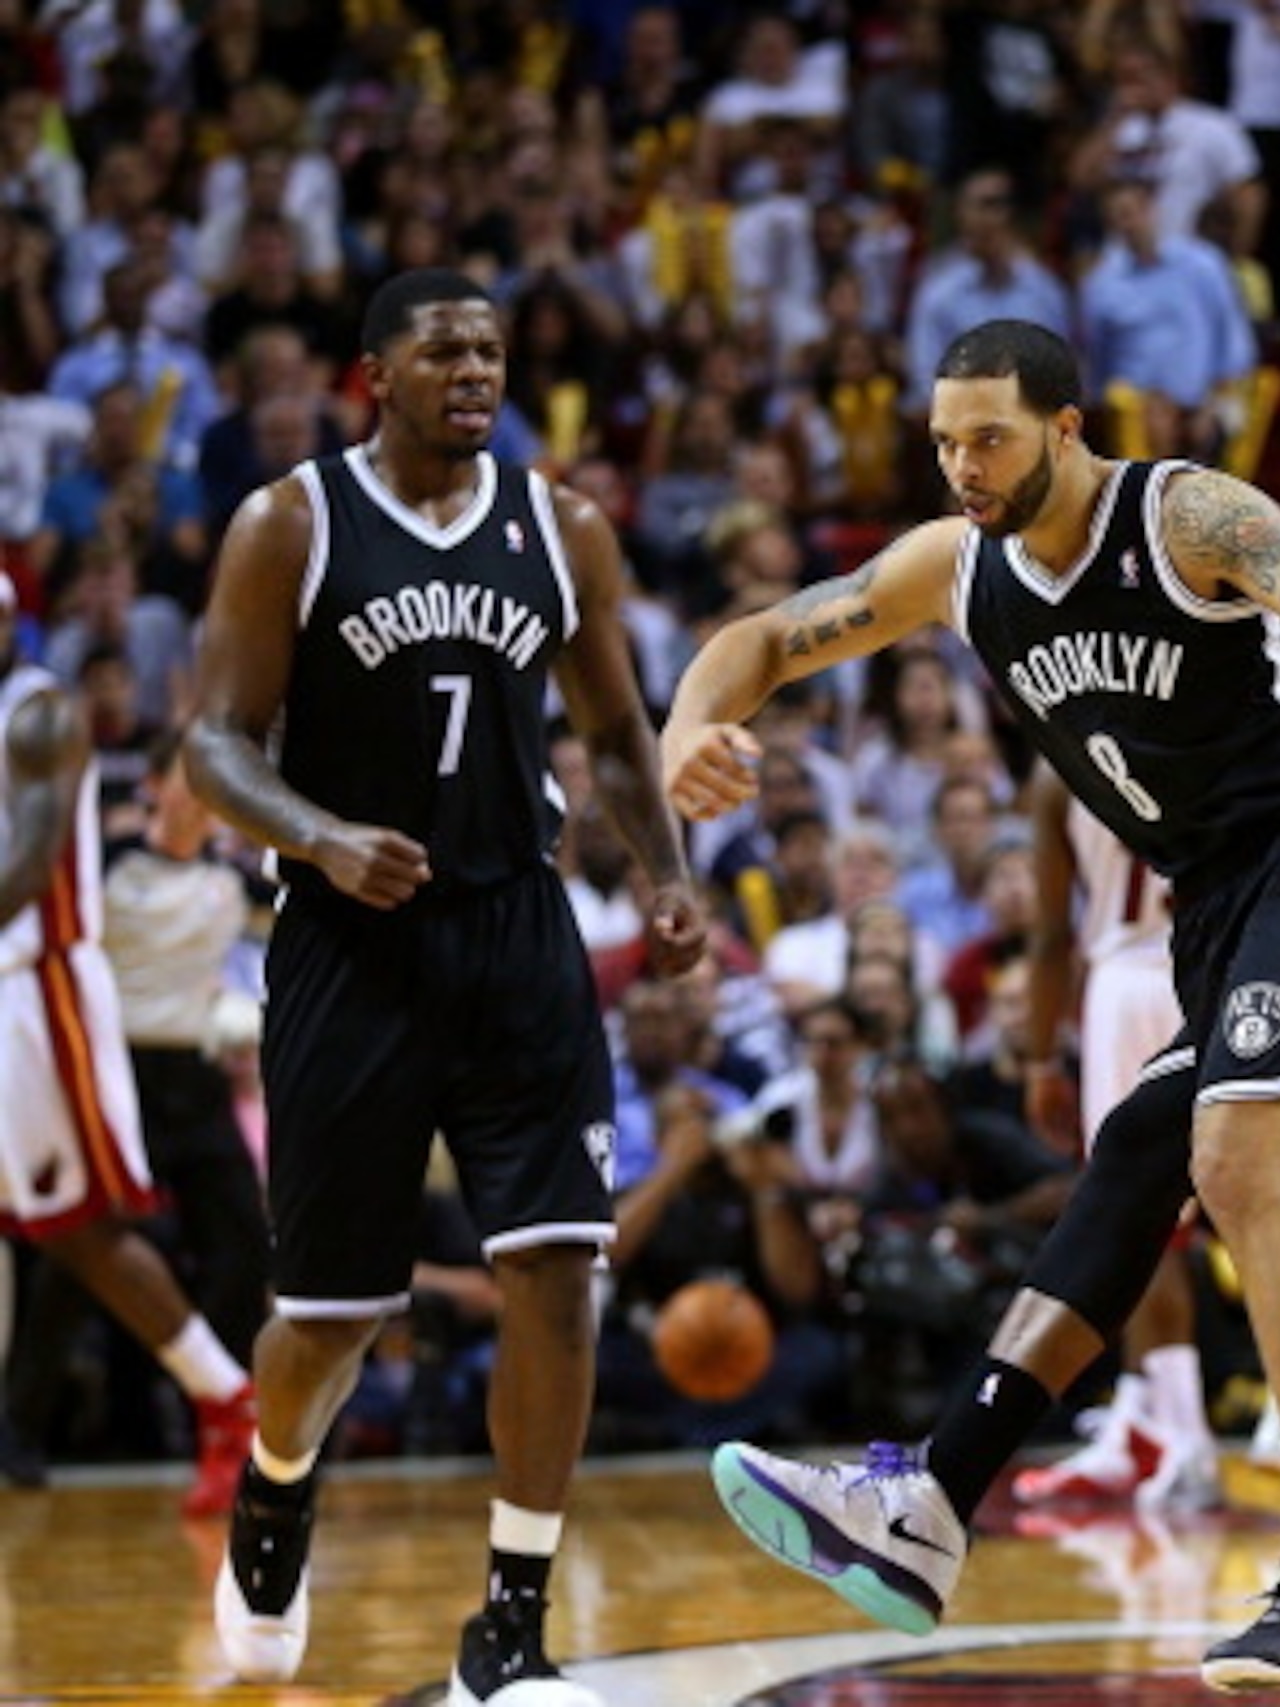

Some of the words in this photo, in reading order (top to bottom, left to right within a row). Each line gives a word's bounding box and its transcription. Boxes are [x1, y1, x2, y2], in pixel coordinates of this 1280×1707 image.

[338, 580, 549, 671] BROOKLYN
[1009, 631, 1184, 721] ROOKLYN
[431, 674, 472, 777] 7
[1086, 733, 1162, 822] 8
